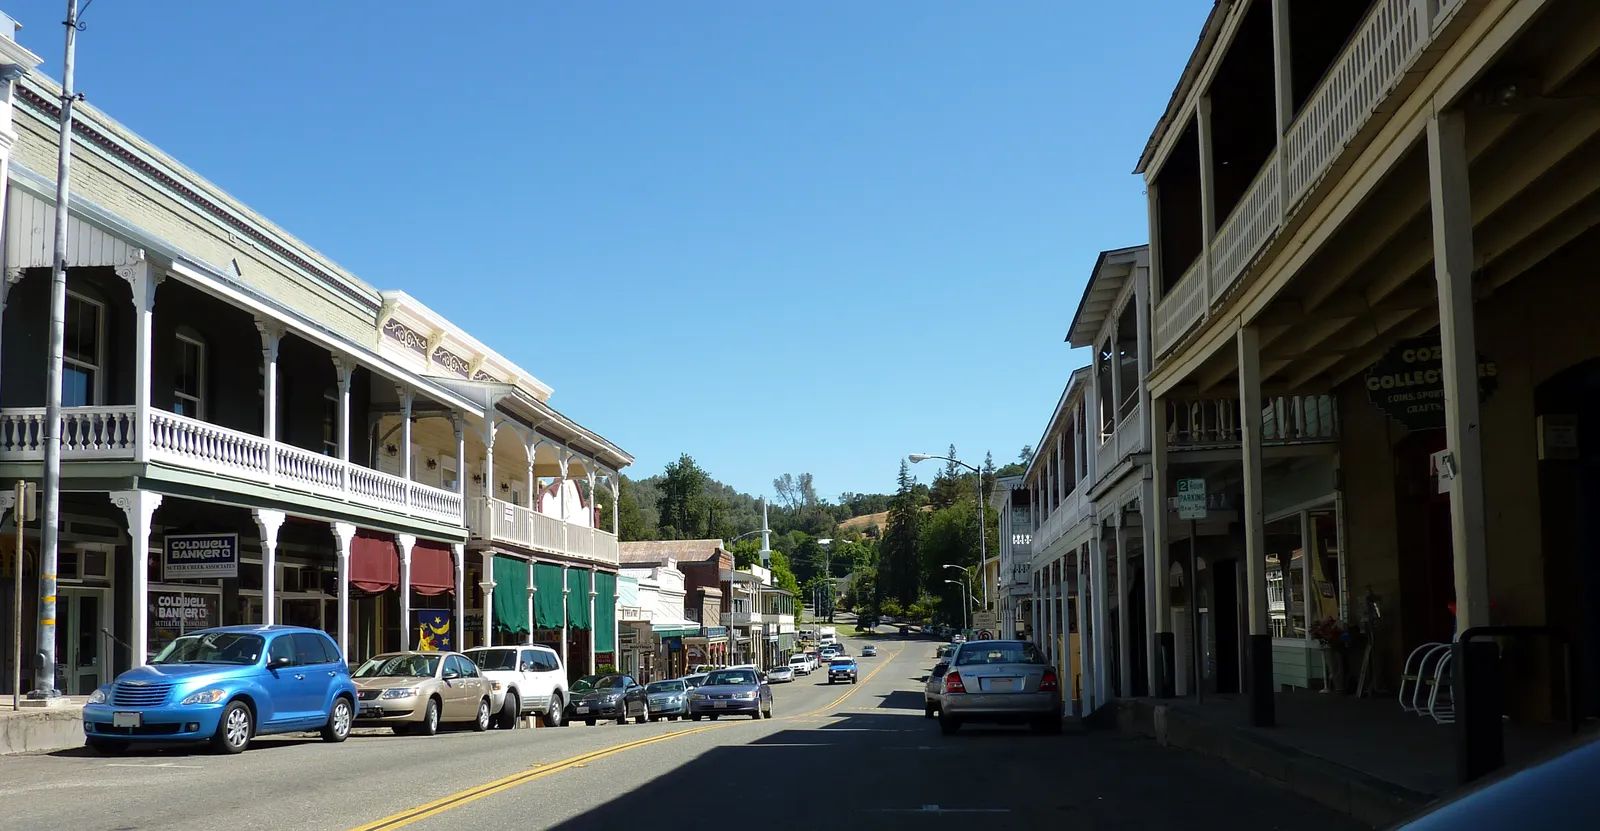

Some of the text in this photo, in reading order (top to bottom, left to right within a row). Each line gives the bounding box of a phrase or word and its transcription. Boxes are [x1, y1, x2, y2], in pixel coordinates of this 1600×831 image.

[1402, 345, 1442, 363] COZ
[1179, 481, 1187, 491] 2
[1178, 493, 1205, 502] PARKING
[171, 539, 231, 550] COLDWELL
[172, 549, 220, 559] BANKER
[158, 596, 206, 607] COLDWELL
